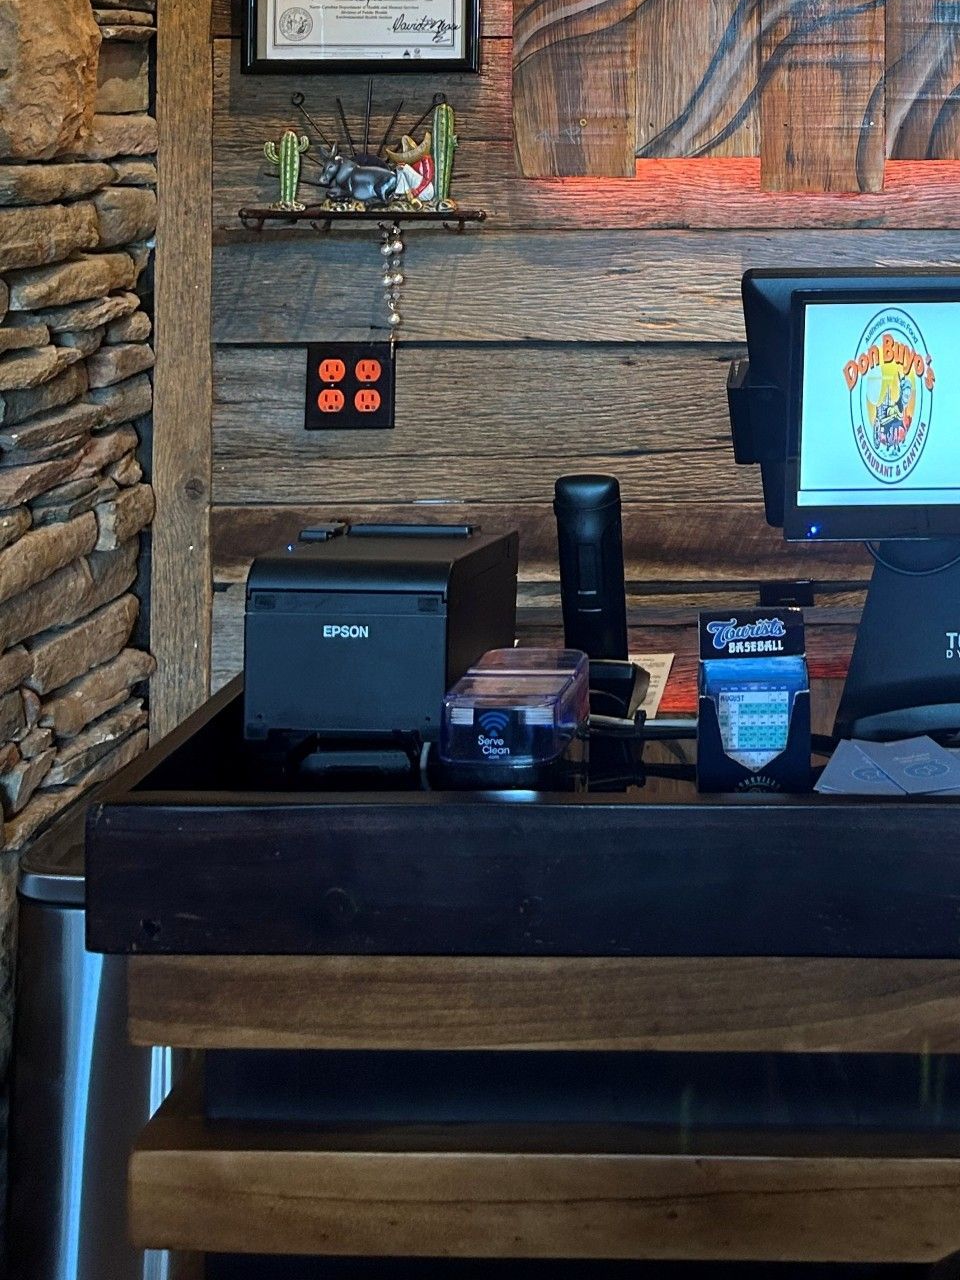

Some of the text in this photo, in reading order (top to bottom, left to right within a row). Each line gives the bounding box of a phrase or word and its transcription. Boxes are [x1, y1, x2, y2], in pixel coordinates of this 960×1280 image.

[886, 315, 906, 328] Mexican
[906, 322, 918, 344] Food
[843, 333, 936, 392] Don Buyo's
[856, 422, 926, 478] RESTAURANT & CANTINA
[323, 625, 369, 638] EPSON
[706, 617, 787, 650] Tourists
[728, 640, 784, 654] BASEBALL
[720, 694, 744, 703] AUGUST
[477, 733, 505, 747] Serve
[481, 745, 510, 756] Clean
